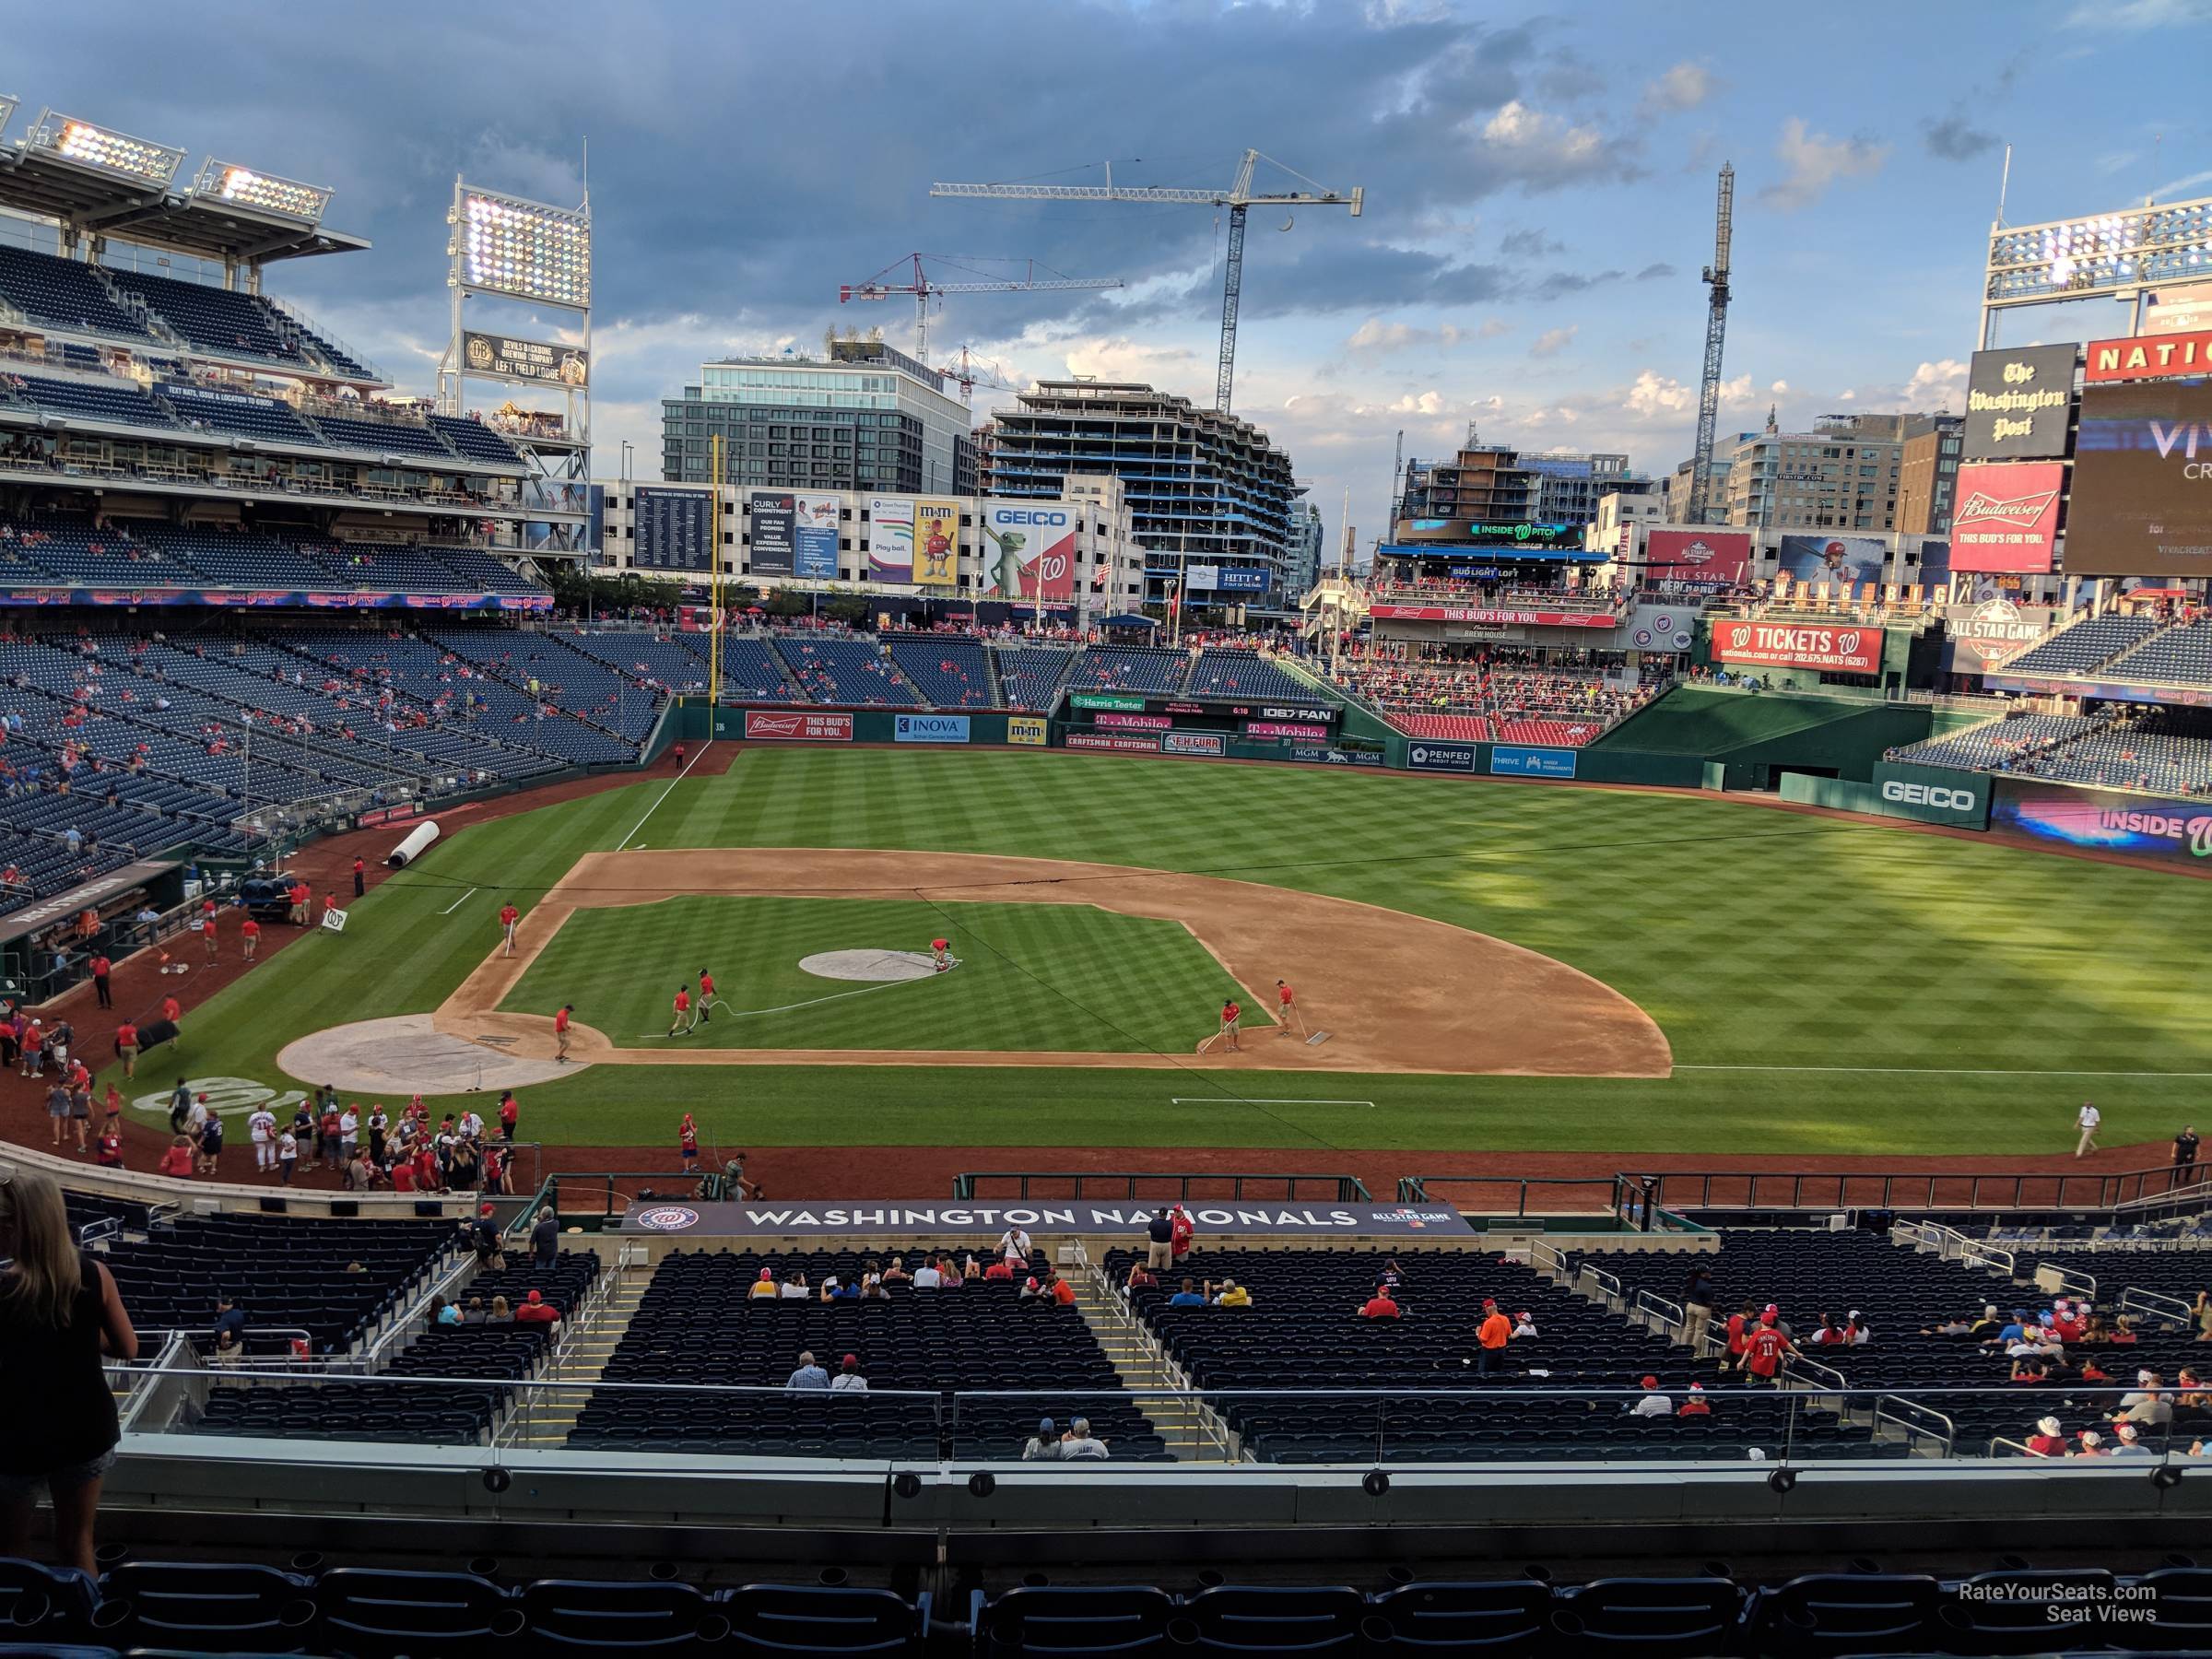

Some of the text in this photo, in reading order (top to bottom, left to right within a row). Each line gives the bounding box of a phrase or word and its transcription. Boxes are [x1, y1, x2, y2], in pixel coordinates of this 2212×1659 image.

[473, 342, 488, 358] DB
[503, 340, 552, 356] DEVILS BACKBONE
[501, 347, 554, 364] BREWING COMPANY
[495, 359, 514, 372] LEFT
[515, 362, 535, 376] FIELD
[536, 365, 560, 380] LODGE
[2004, 361, 2035, 384] The
[168, 386, 182, 394] TEXT
[199, 390, 215, 399] ISSUE
[221, 394, 246, 404] LOCATION
[1969, 388, 2066, 412] Washington
[1993, 416, 2033, 441] Post
[753, 500, 782, 509] CURLY
[1964, 500, 2043, 516] Budweiser
[995, 510, 1066, 527] GEICO
[1481, 525, 1513, 535] INSIDE
[1532, 528, 1556, 536] PITCH
[1959, 534, 2044, 544] THIS BUD'S FOR YOU.
[876, 544, 891, 552] Play
[1618, 536, 1629, 559] TEAM
[1224, 573, 1253, 582] HITT
[1696, 571, 1725, 582] STAR
[1443, 609, 1465, 619] THIS
[1466, 610, 1495, 621] BUD'S
[1497, 612, 1515, 622] FOR
[1518, 613, 1539, 623] YOU.
[1485, 630, 1507, 639] HOUSE
[1950, 621, 2042, 640] ALL STAR GAME
[1757, 628, 1832, 653] TICKETS
[1721, 649, 1769, 659] nationals.com
[1779, 653, 1793, 662] call
[1794, 653, 1844, 665] 202.675.NATS
[1845, 656, 1868, 668] (6287)
[1084, 699, 1143, 710] Harris Teeter
[1299, 709, 1331, 720] FAN
[715, 723, 725, 732] 336
[752, 719, 797, 729] Budweiser
[806, 716, 851, 727] THIS BUD'S
[913, 721, 958, 732] INOVA
[806, 727, 842, 736] FOR YOU.
[1068, 737, 1111, 747] CRAFTSMAN
[1113, 740, 1157, 750] CRAFTSMAN
[1295, 749, 1380, 761] MGM MGM
[1430, 750, 1472, 760] PENFED
[1493, 757, 1520, 766] THRIVE
[1882, 781, 1975, 811] GEICO
[2102, 808, 2184, 839] INSIDE
[745, 1208, 1077, 1226] WASHINGTON
[1420, 1213, 1451, 1221] GAME
[1762, 1342, 1773, 1357] 11
